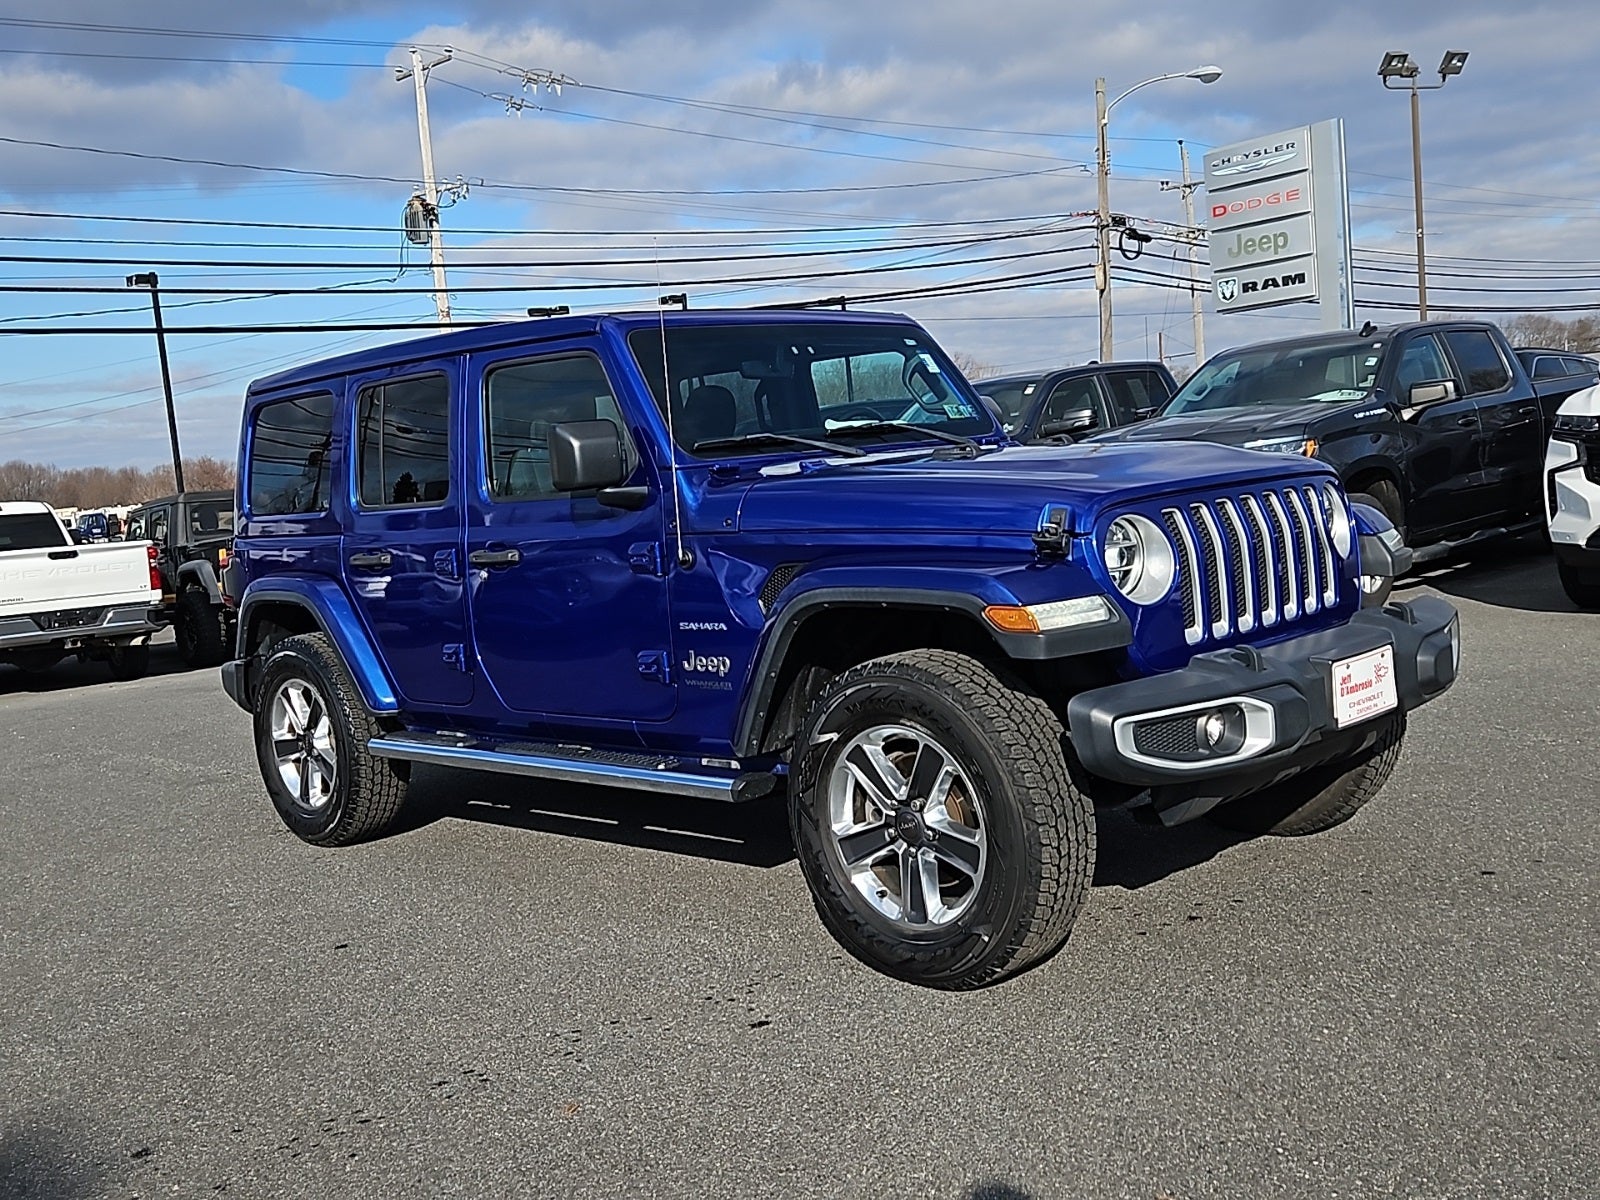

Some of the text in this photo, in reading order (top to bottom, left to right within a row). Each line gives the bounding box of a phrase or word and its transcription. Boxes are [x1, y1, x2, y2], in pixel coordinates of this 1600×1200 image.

[1211, 142, 1296, 167] CHRYSLER
[1212, 188, 1300, 218] DODGE
[1228, 231, 1289, 258] Jeep
[1241, 272, 1306, 294] RAM
[679, 622, 727, 630] SAHARA
[682, 649, 730, 677] Jeep
[1349, 692, 1383, 708] CHEVROLET
